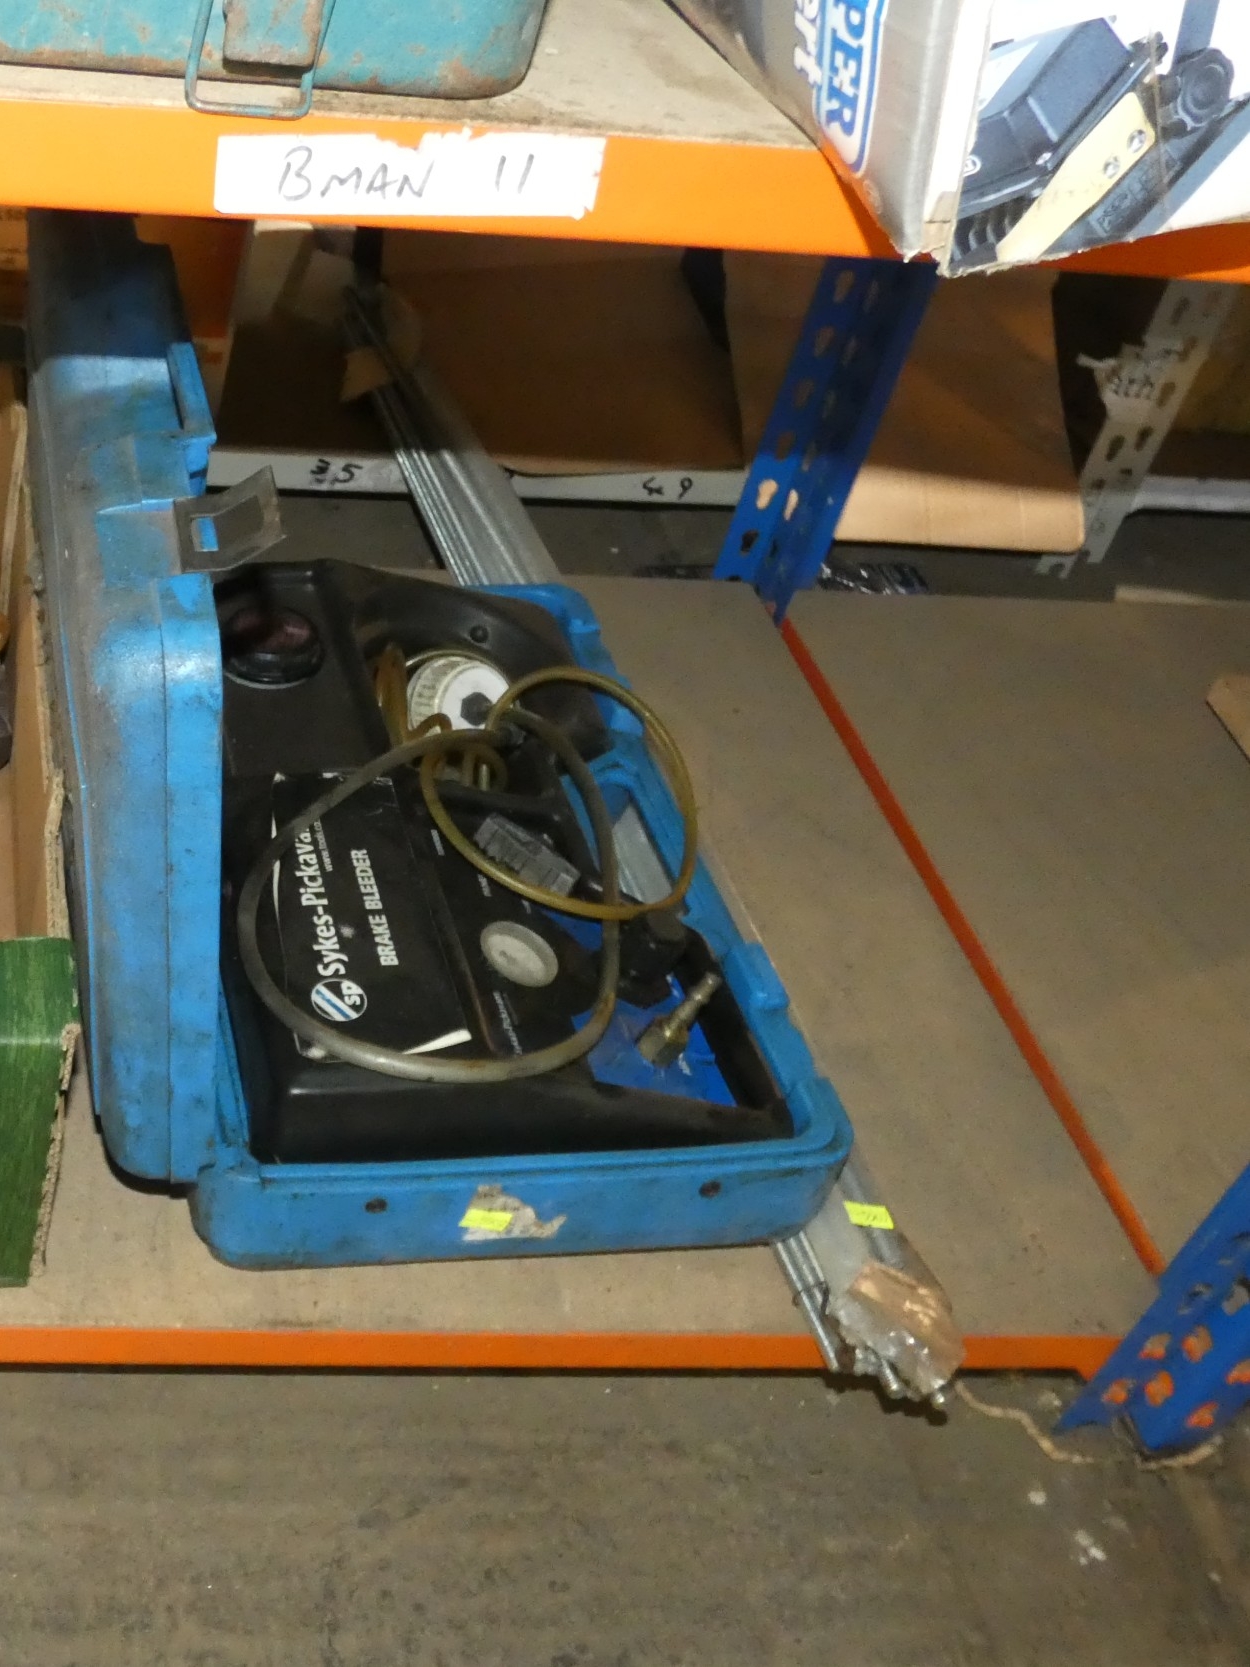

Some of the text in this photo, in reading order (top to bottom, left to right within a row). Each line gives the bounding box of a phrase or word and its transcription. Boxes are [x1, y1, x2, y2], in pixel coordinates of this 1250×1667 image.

[295, 826, 348, 976] Sykes-Pickava
[350, 848, 400, 966] BRAKE BLEEDER
